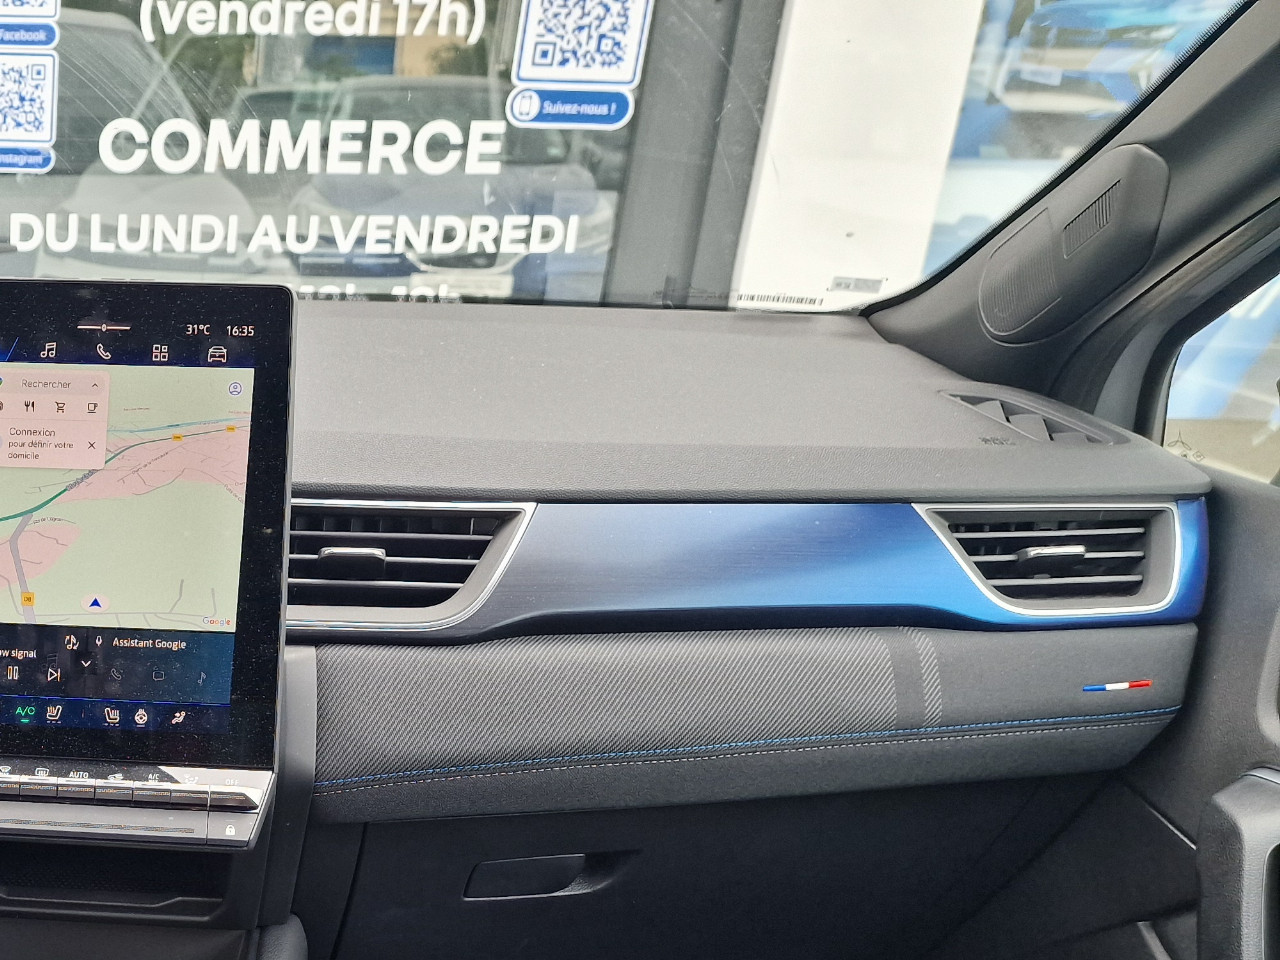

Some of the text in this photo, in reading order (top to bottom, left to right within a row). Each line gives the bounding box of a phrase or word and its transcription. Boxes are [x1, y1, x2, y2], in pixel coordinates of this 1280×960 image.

[542, 100, 609, 115] Suivez-nous
[98, 117, 507, 176] COMMERCE
[10, 213, 580, 254] DU LUNDI AU VENDREDI
[186, 324, 211, 335] 31°C
[226, 325, 255, 336] 16:35
[22, 379, 72, 389] Rechercher
[9, 427, 56, 437] Connexion
[8, 441, 26, 449] pour
[54, 441, 74, 449] votre
[8, 451, 40, 460] domicile
[202, 616, 231, 627] Google
[112, 637, 187, 651] Assistant Google
[11, 648, 37, 660] signal
[15, 706, 36, 716] A/C
[69, 771, 89, 779] AUTO
[225, 778, 239, 786] OFF
